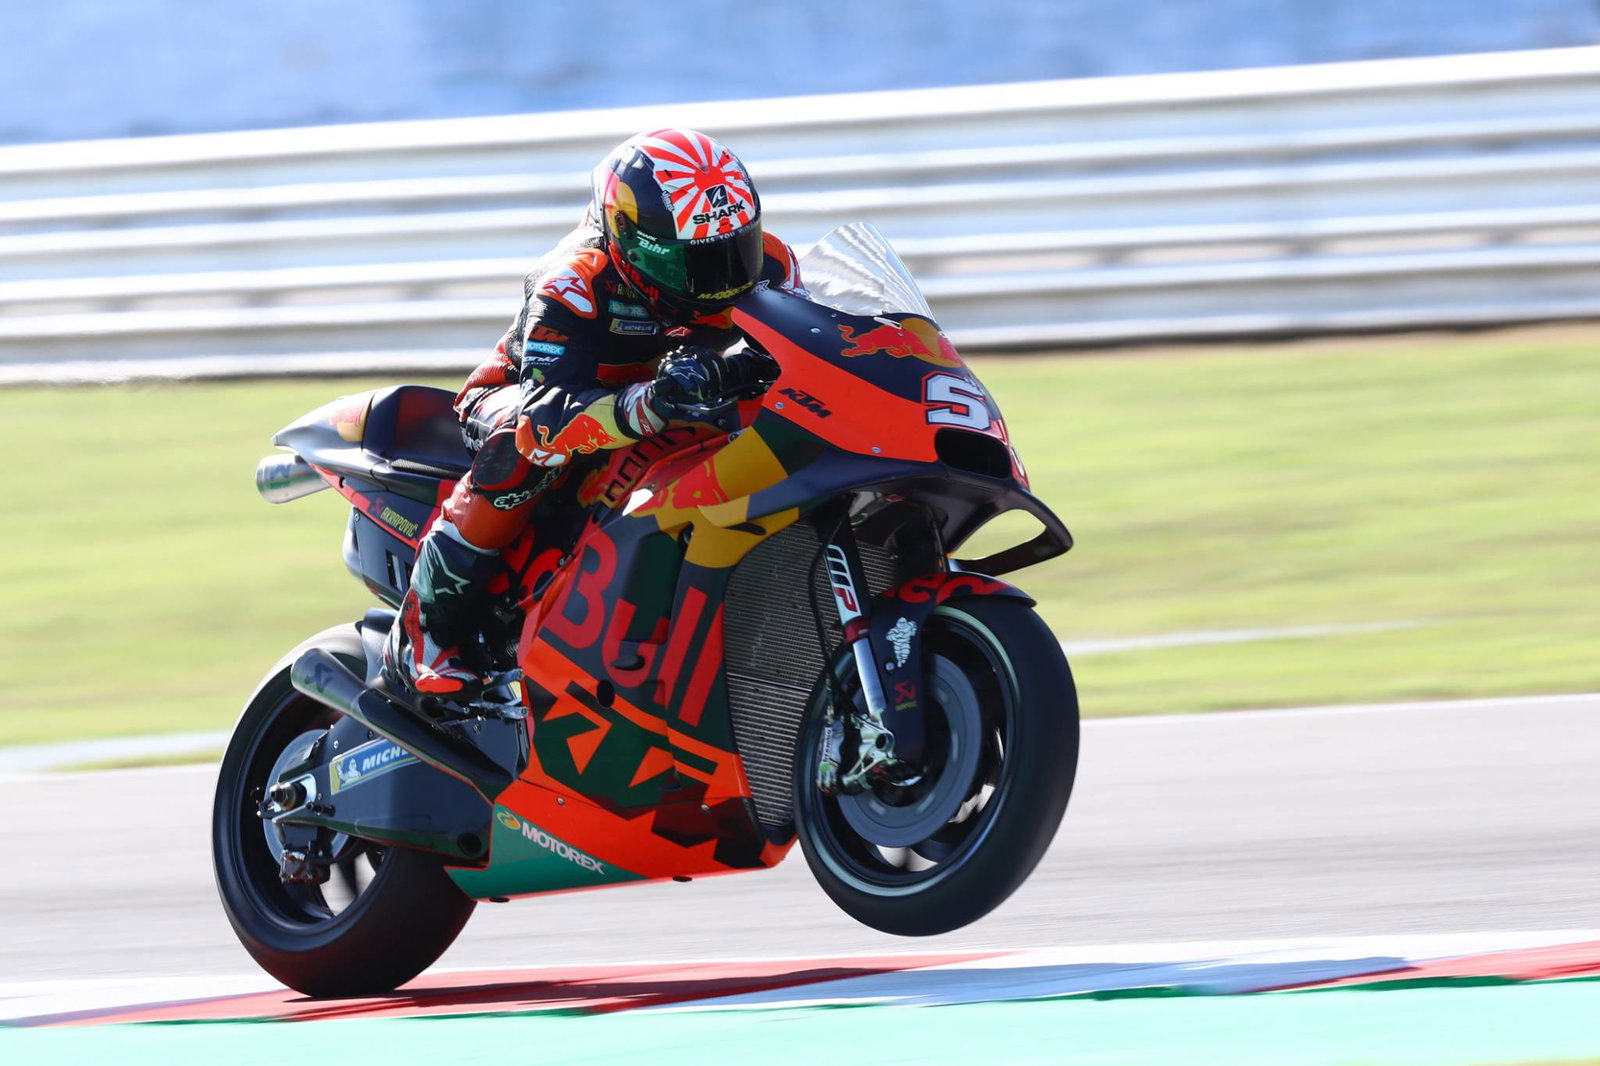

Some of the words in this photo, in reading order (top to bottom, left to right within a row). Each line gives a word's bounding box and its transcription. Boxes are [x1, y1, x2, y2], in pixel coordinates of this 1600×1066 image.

[692, 199, 746, 226] SHARK
[525, 342, 563, 355] OTOREX
[778, 388, 832, 419] KTM
[922, 371, 991, 431] 5
[543, 530, 724, 727] Bull
[521, 821, 606, 876] MOTOREX
